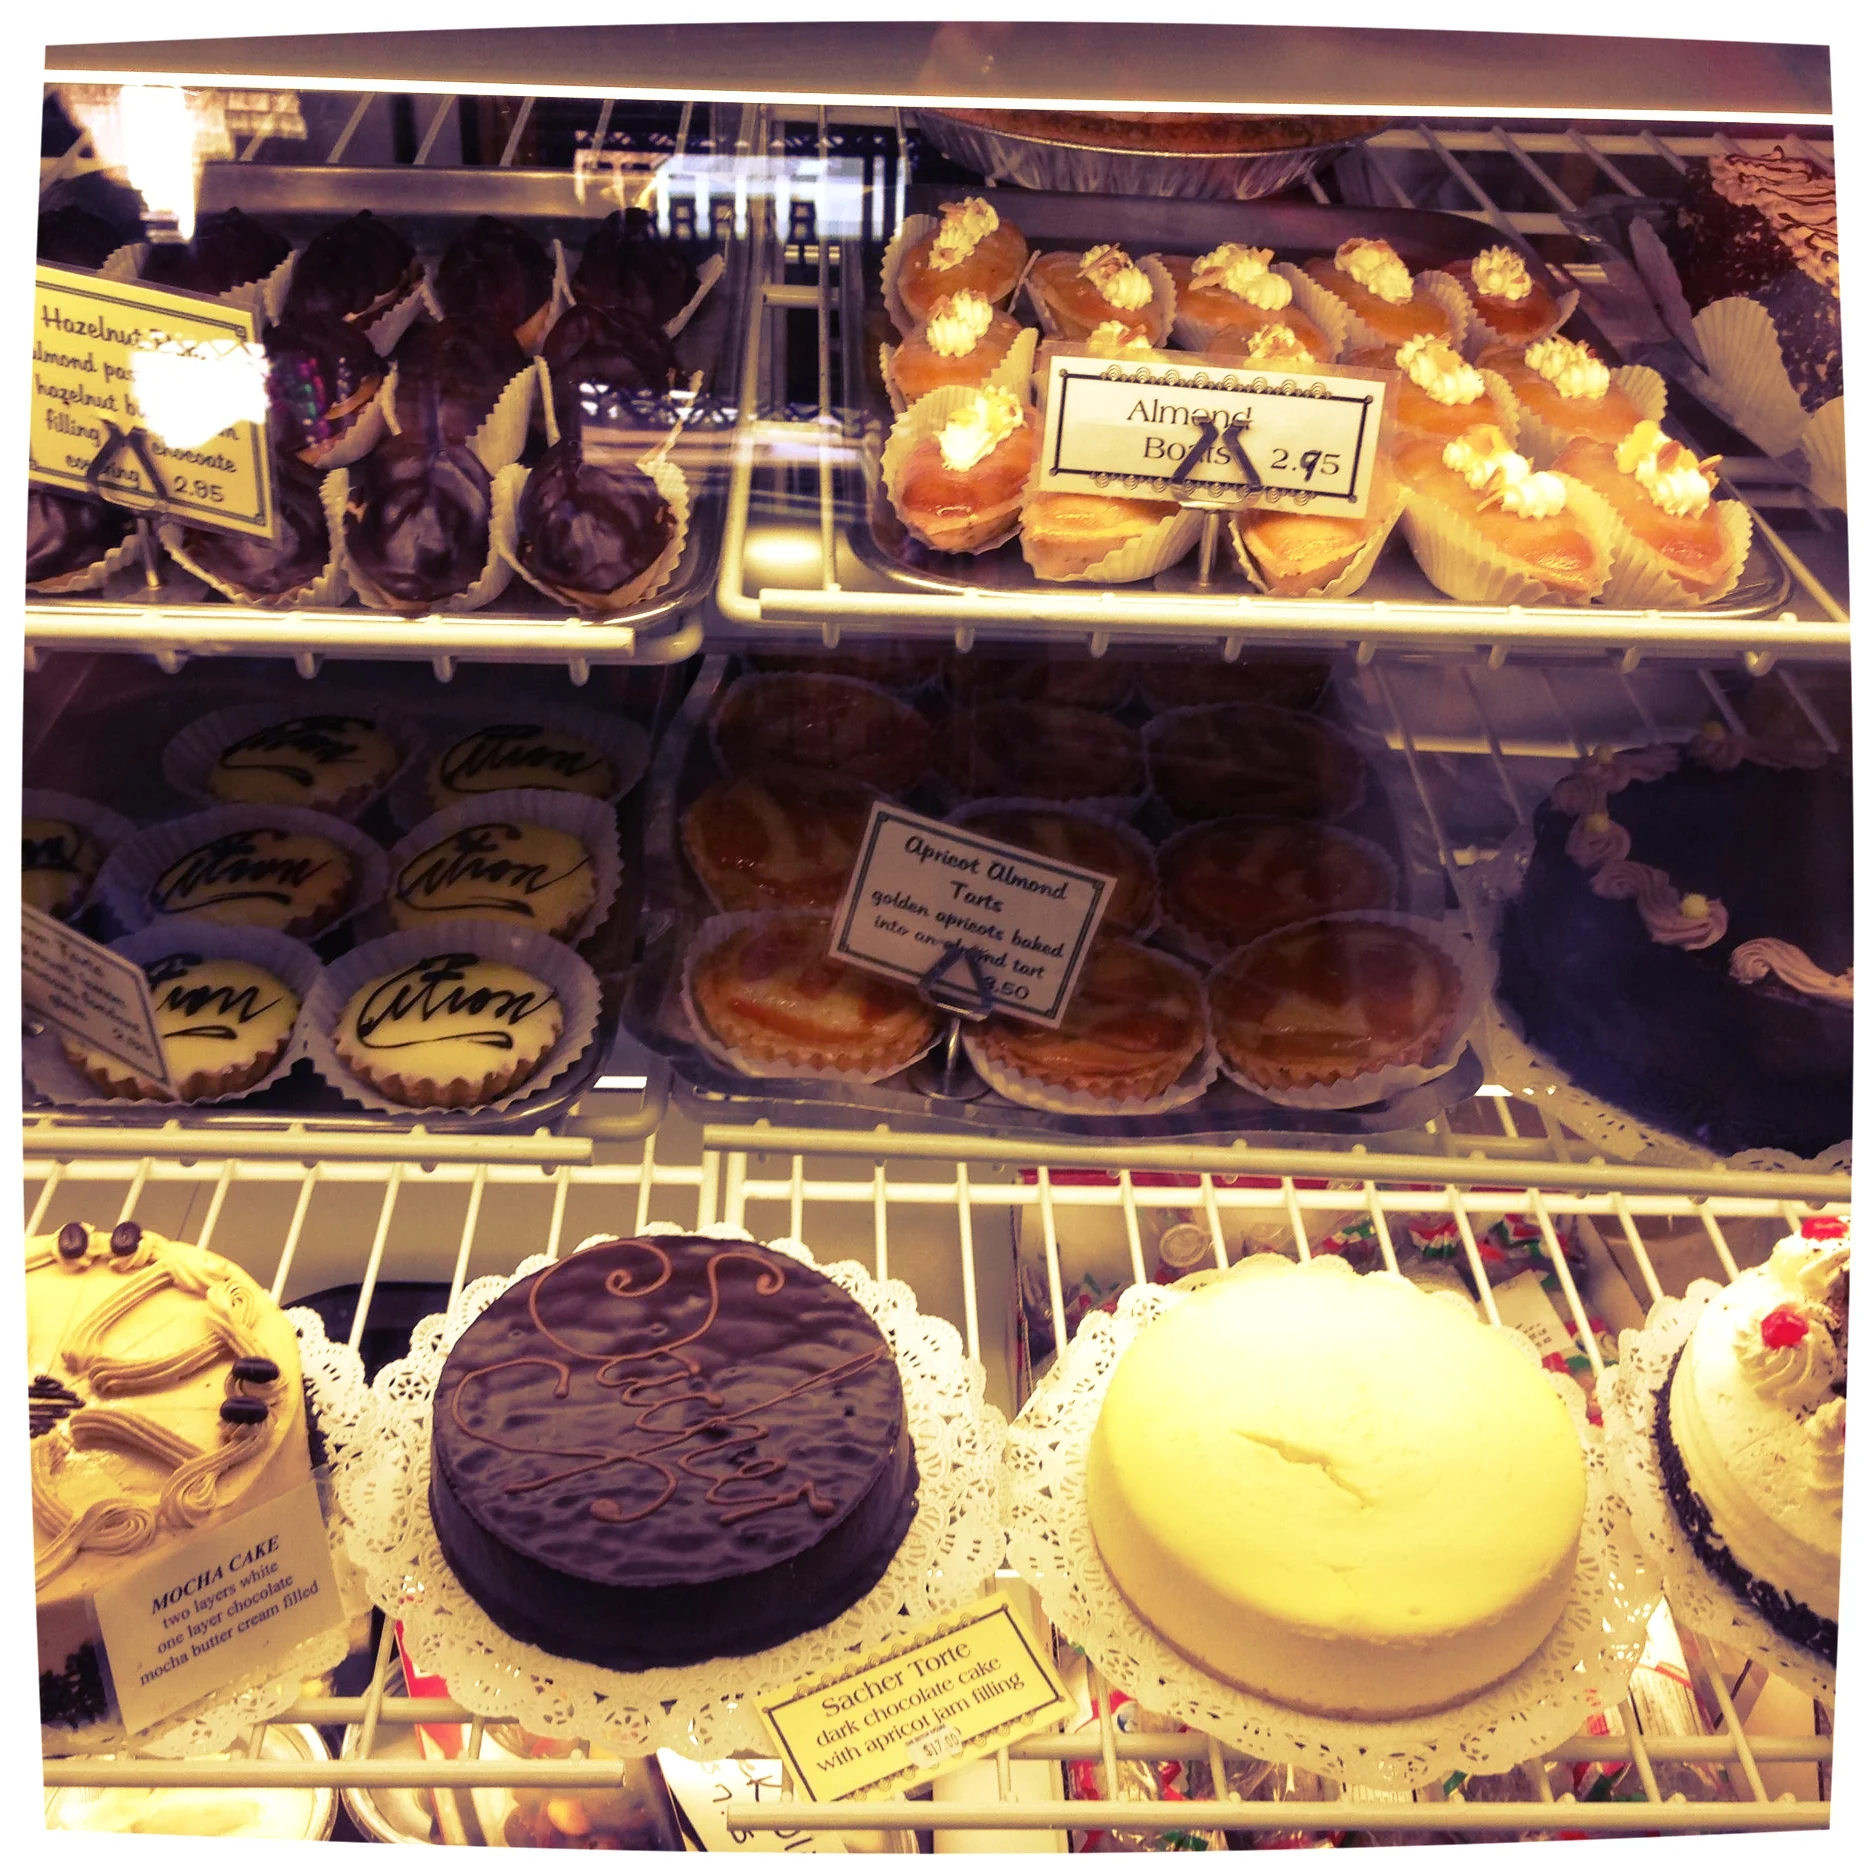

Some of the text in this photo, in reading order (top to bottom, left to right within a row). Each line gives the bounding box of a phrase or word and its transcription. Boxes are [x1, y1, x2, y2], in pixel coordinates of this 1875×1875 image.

[35, 373, 119, 413] hazelnut
[46, 408, 101, 449] filling
[1270, 447, 1341, 483] 2.95
[904, 835, 1069, 901] Apricot Almond
[950, 880, 1004, 913] Tarts
[871, 890, 1064, 959] golden apricots baked
[874, 914, 910, 936] into
[1012, 959, 1046, 979] tart
[151, 1534, 280, 1615] MOCHA CAKE
[162, 1561, 279, 1630] two layers white
[139, 1579, 320, 1687] mocha butter cream filled
[157, 1574, 294, 1655] one layer chocolate
[816, 1655, 1003, 1748] dark chocolate cake
[821, 1640, 972, 1718] Sacher Torte
[815, 1742, 863, 1774] with
[864, 1714, 931, 1757] apricot
[931, 1698, 973, 1725] jam
[971, 1671, 1025, 1712] filling
